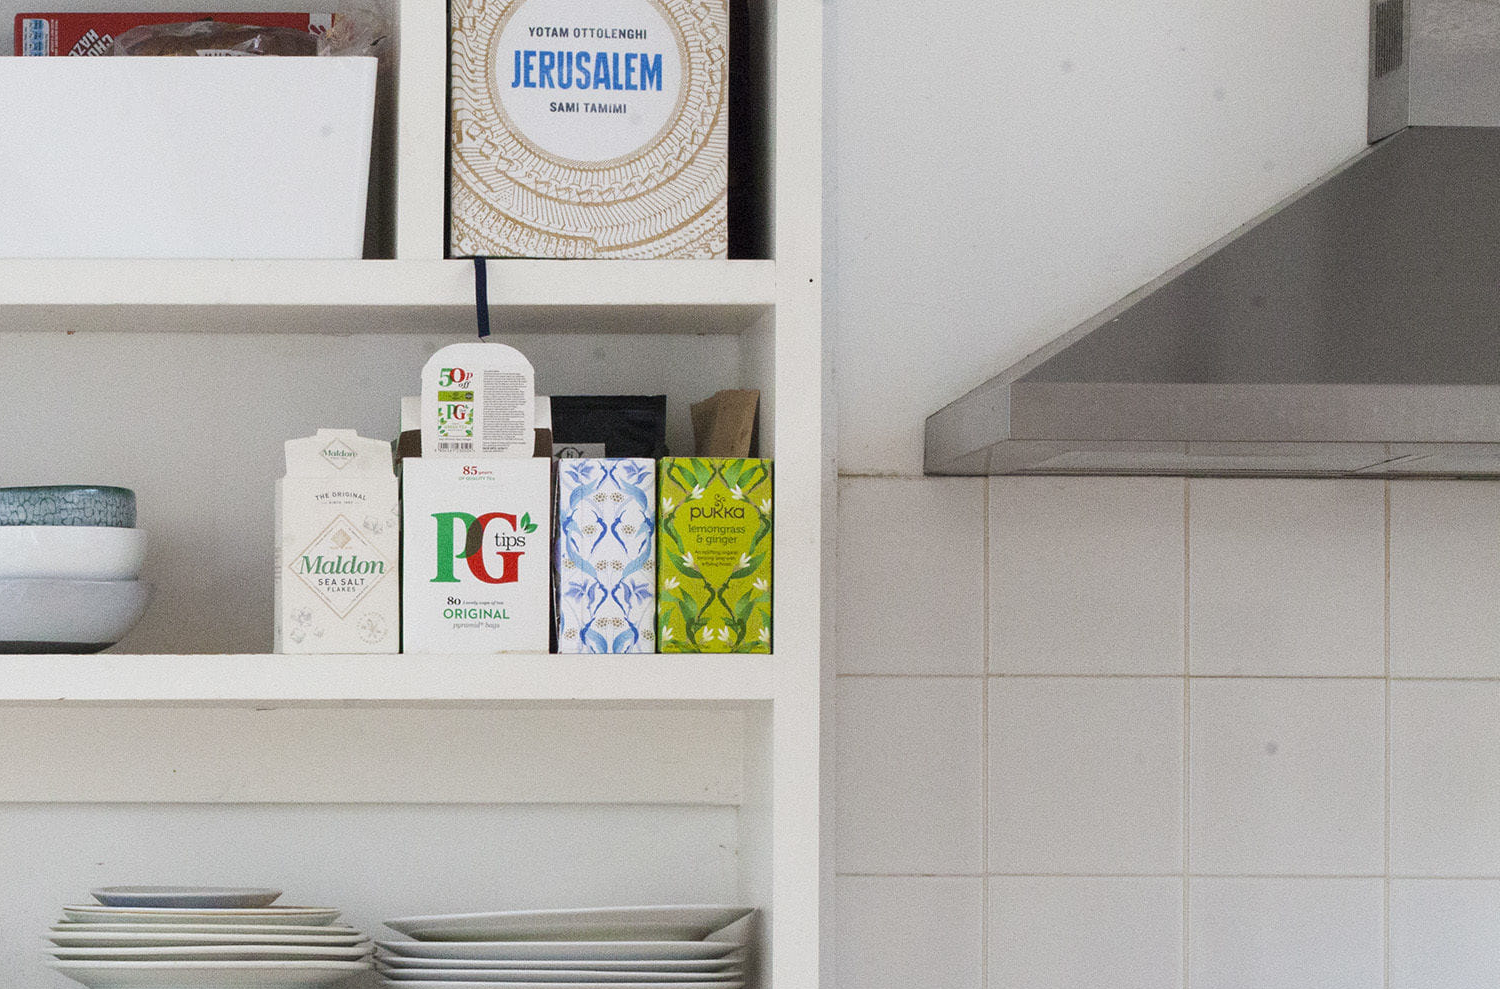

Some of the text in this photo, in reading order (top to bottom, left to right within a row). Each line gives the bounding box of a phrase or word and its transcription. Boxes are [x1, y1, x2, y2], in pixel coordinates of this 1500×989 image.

[528, 26, 647, 40] YOTAM OTTOLENGHI
[511, 50, 663, 92] JERUSALEM
[549, 101, 627, 114] SAMI TAMIMI
[462, 465, 478, 476] 85
[315, 491, 367, 501] THE ORIGINAL
[690, 505, 745, 521] pukka
[688, 524, 746, 535] lemongrass
[495, 532, 526, 551] tips
[696, 535, 737, 546] & ginger
[429, 512, 525, 584] PG
[300, 555, 385, 575] Maldon
[318, 578, 365, 586] SEA SALT
[447, 596, 462, 606] 80
[443, 608, 510, 620] ORIGINAL
